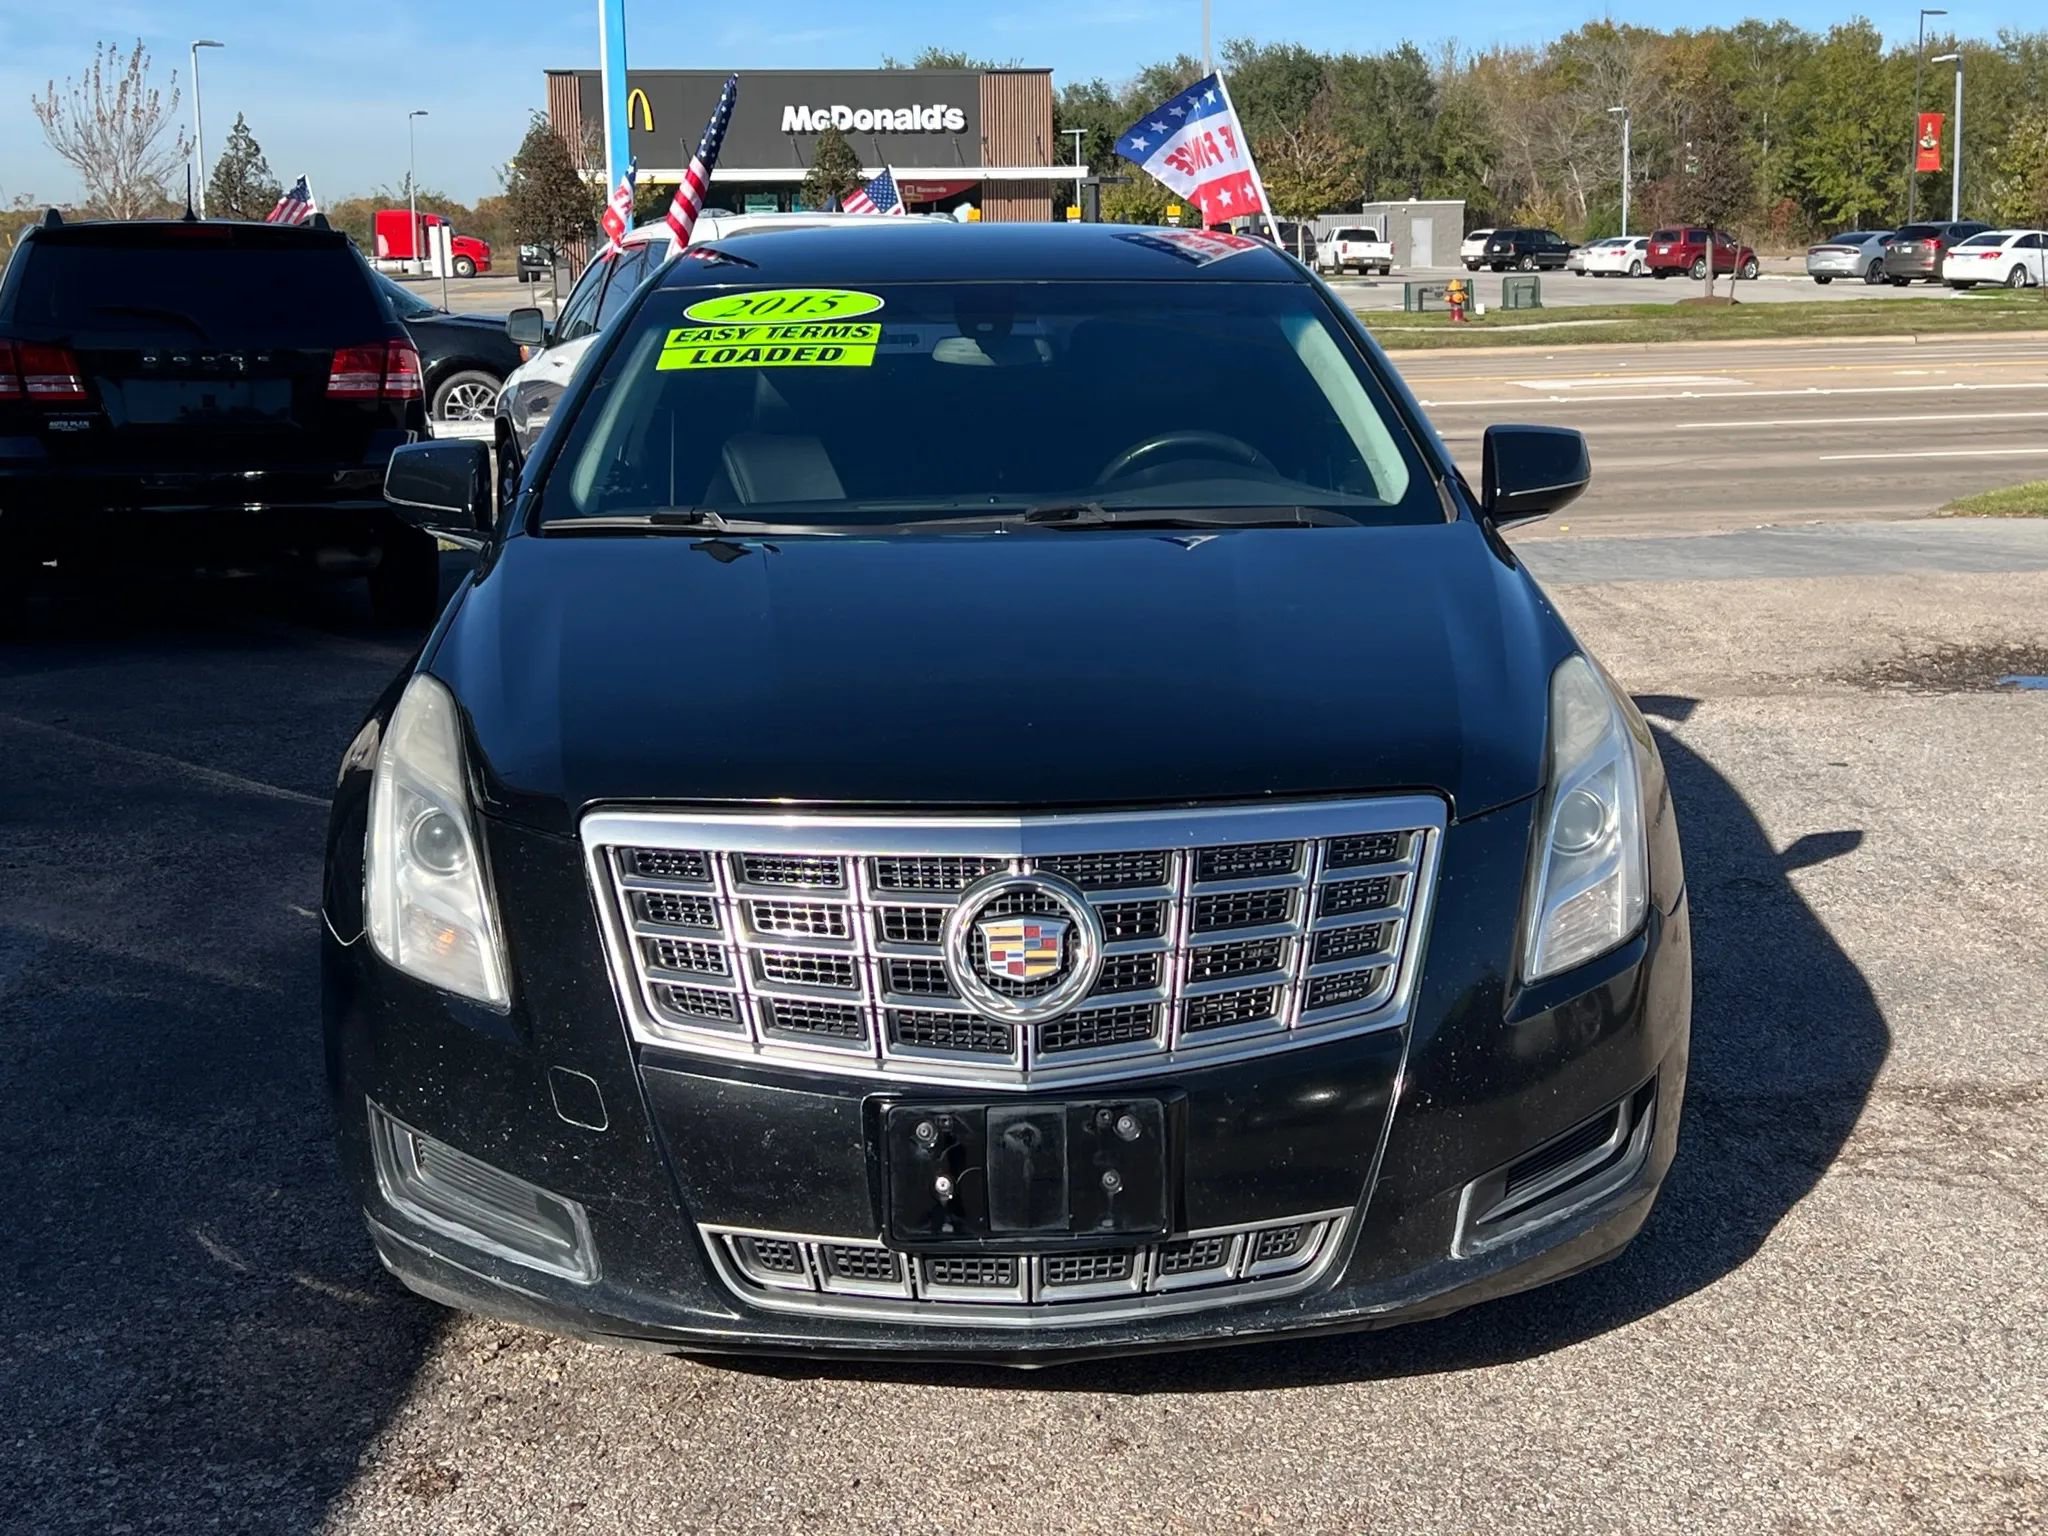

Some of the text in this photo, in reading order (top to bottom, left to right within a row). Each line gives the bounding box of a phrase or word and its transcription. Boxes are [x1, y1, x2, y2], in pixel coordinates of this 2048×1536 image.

[781, 104, 966, 132] McDonald's
[714, 294, 849, 319] 2015
[672, 325, 874, 344] EASY TERMS
[689, 346, 845, 365] LOADED
